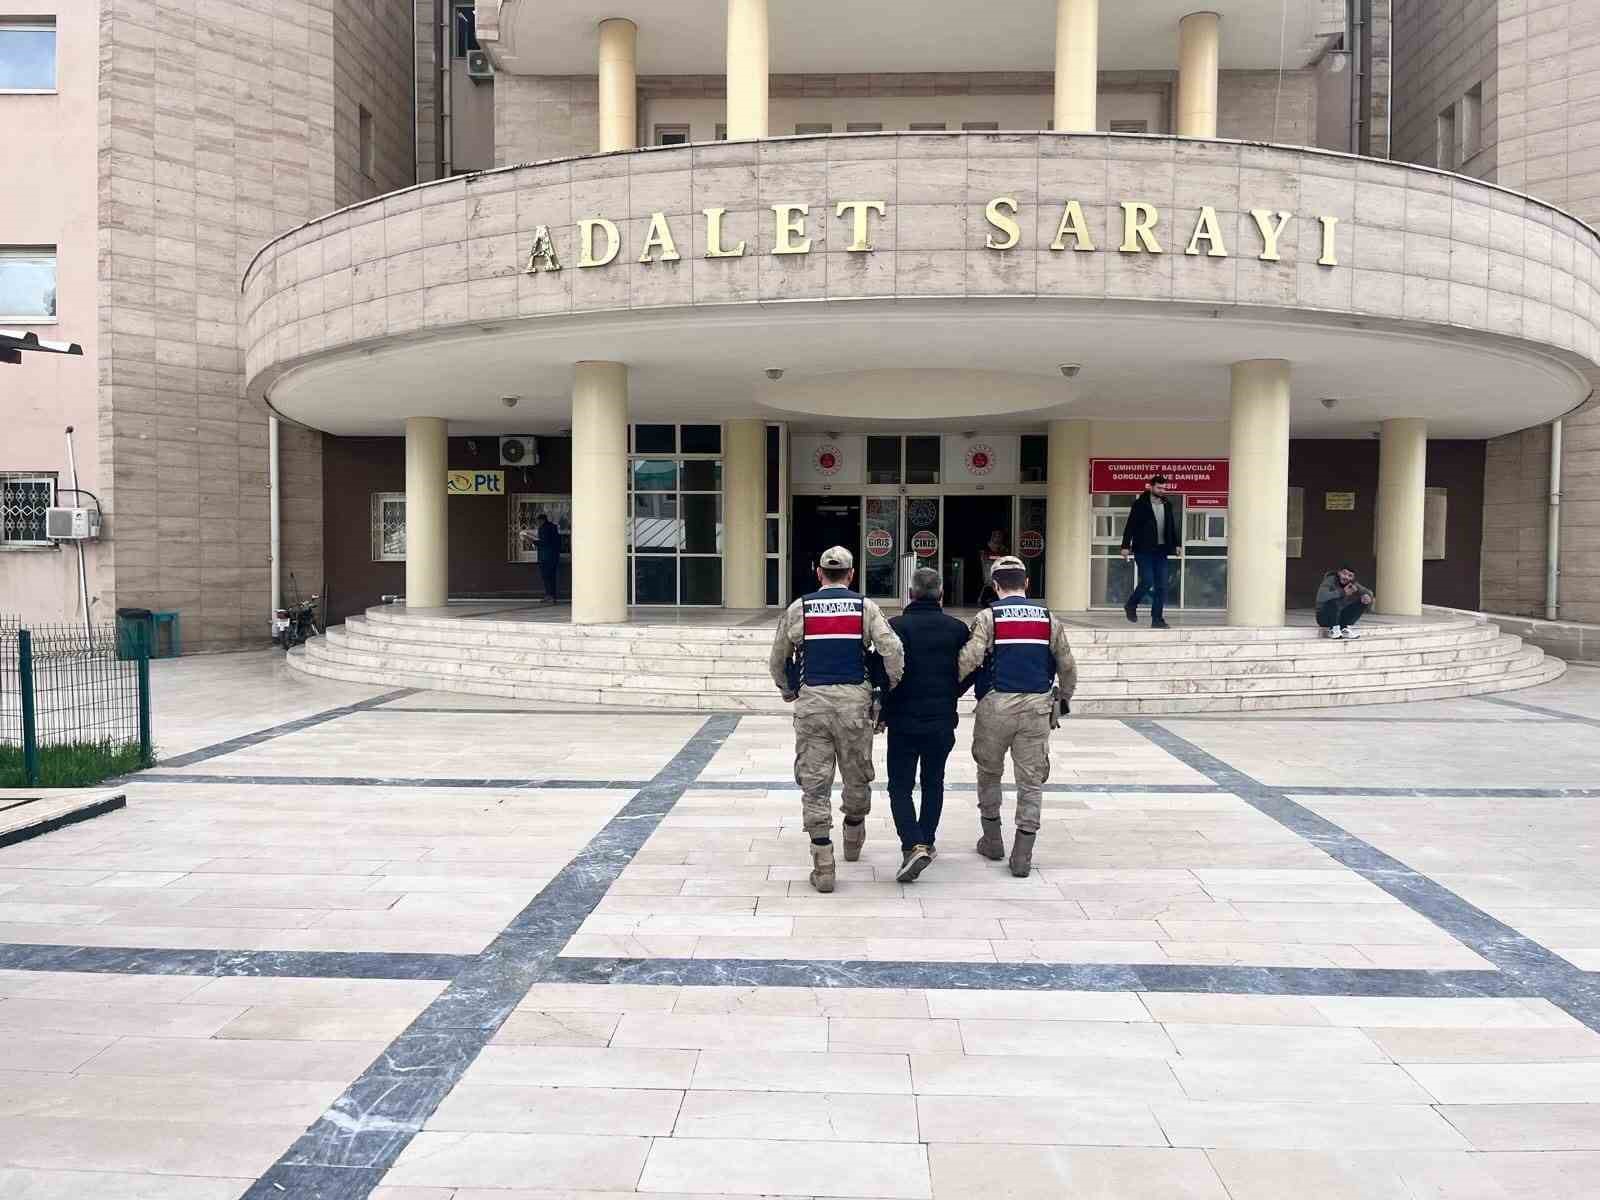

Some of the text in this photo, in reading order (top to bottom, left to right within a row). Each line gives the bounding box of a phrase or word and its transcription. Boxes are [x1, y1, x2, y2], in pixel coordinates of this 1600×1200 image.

[525, 197, 1338, 273] ADALET SARAYI
[474, 474, 501, 492] Ptt
[1175, 473, 1211, 482] DANIŞMA
[808, 602, 857, 613] JANDARMA
[1001, 607, 1046, 618] JANDARMA
